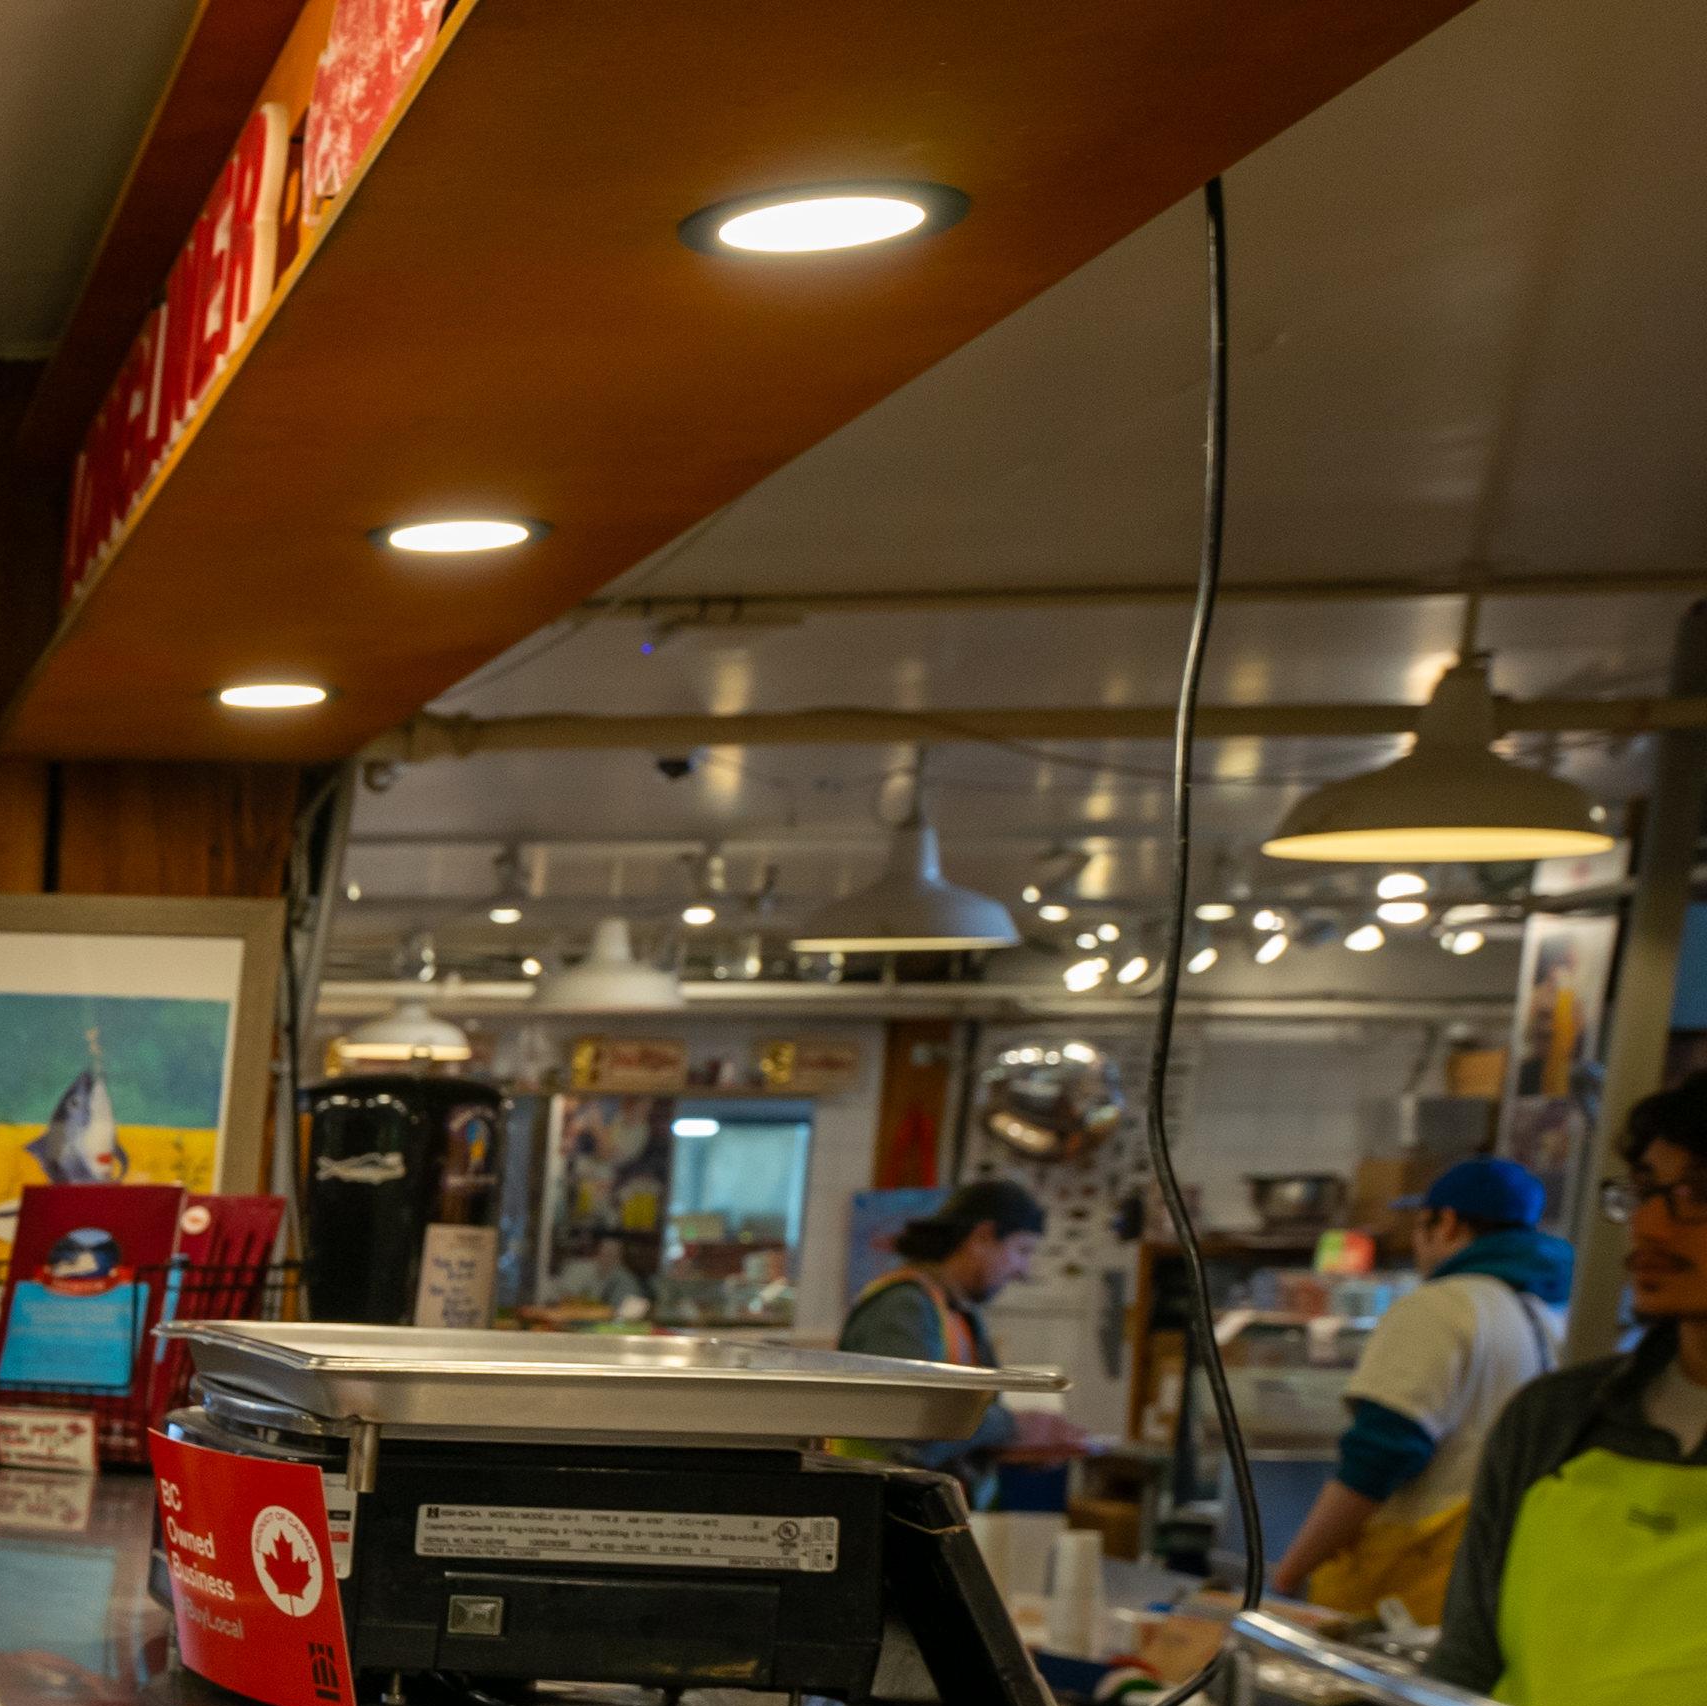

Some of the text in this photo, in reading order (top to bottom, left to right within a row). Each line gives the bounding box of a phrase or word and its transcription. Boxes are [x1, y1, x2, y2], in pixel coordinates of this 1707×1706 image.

[160, 1477, 183, 1512] BC
[166, 1515, 216, 1560] Owned
[170, 1550, 236, 1602] Business
